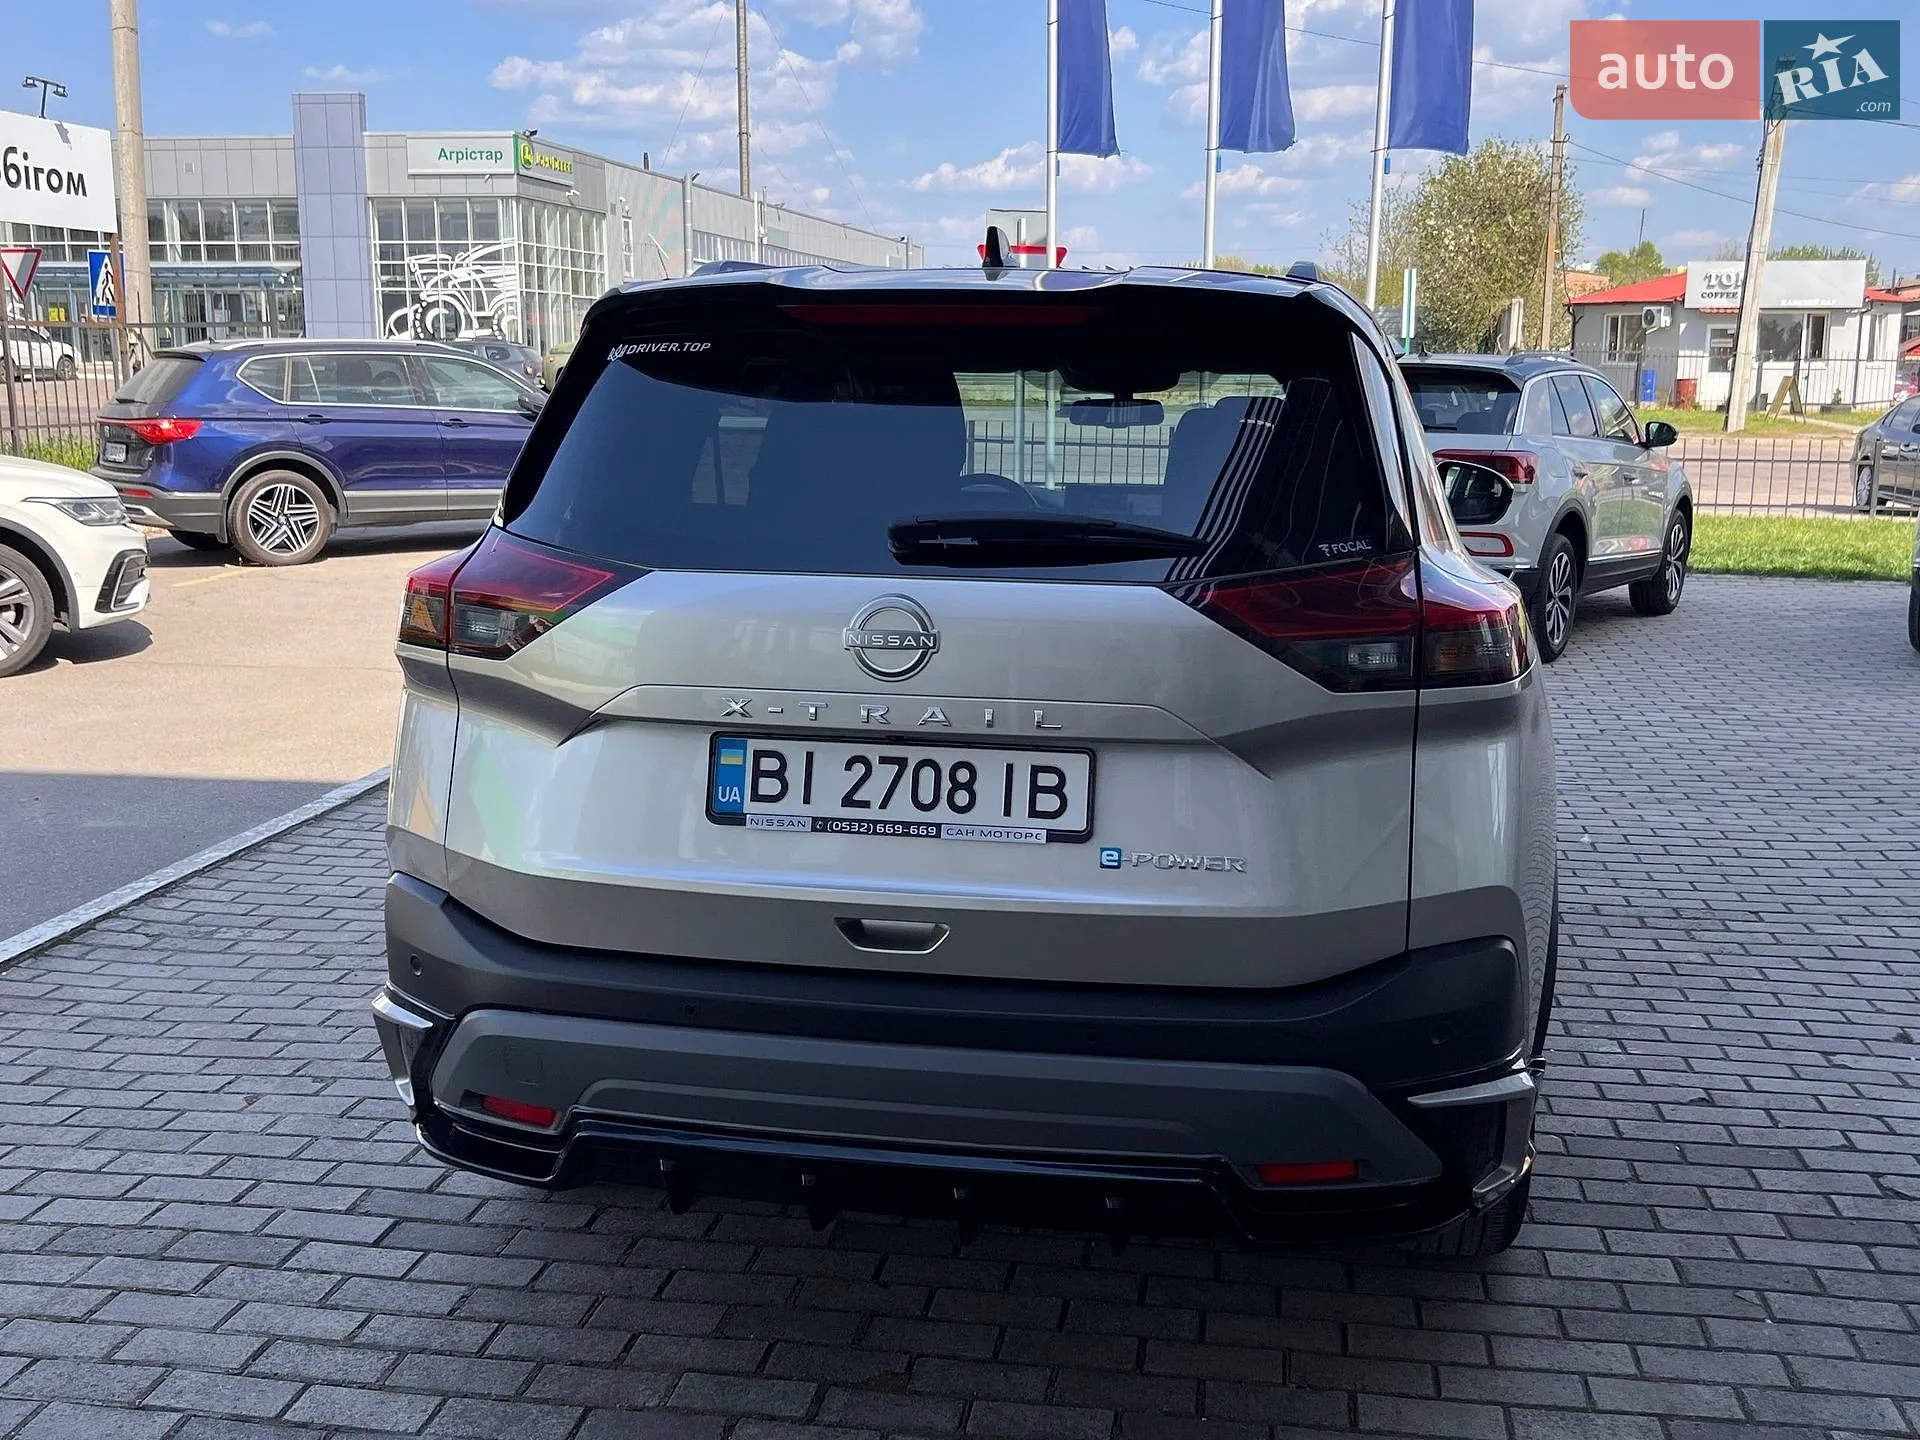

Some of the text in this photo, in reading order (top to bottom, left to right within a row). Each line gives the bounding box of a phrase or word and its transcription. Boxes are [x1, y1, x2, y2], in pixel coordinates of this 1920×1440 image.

[438, 147, 503, 164] Агрістар
[0, 146, 88, 198] бігом
[1700, 291, 1739, 300] COFFEE
[626, 342, 712, 355] DRIVER.TOP
[1331, 540, 1372, 554] FOCAL
[848, 634, 935, 647] NISSAN
[720, 697, 1063, 728] X-TRAIL
[750, 749, 1068, 820] BI 2708 IB
[718, 785, 741, 803] UA
[750, 817, 936, 836] NISSAN (0532) 669-669
[1101, 850, 1247, 873] e-POWER
